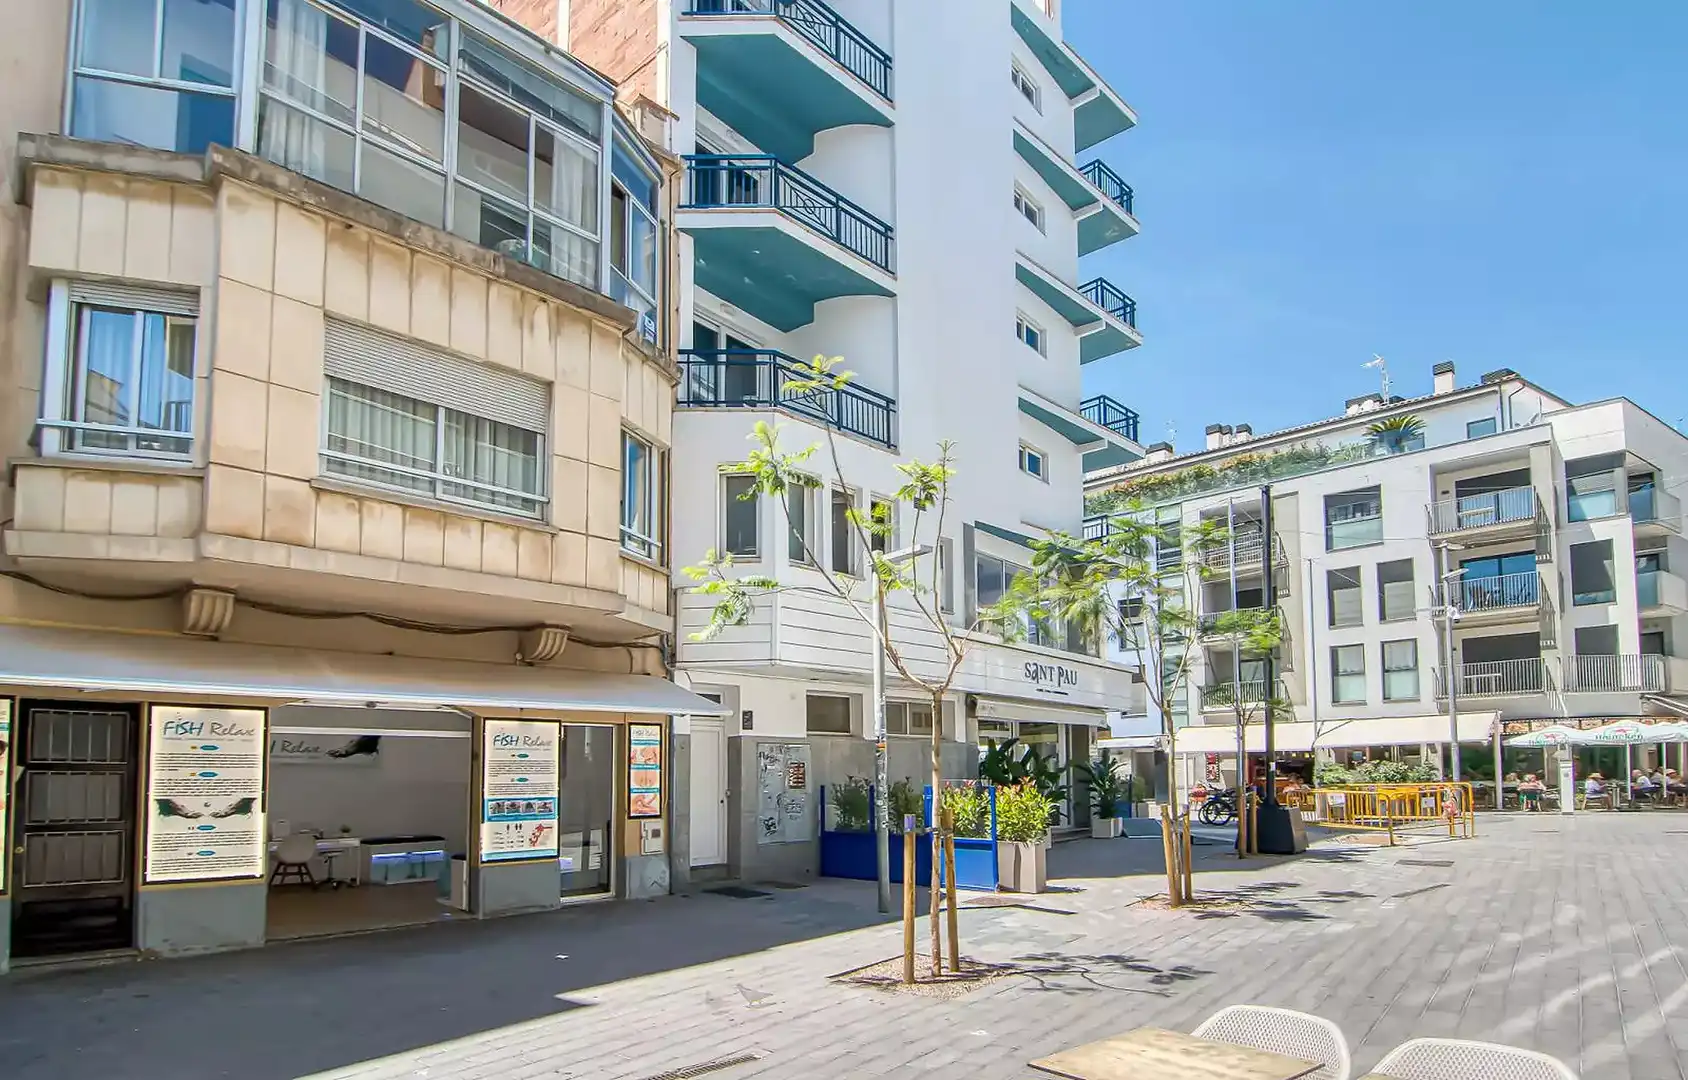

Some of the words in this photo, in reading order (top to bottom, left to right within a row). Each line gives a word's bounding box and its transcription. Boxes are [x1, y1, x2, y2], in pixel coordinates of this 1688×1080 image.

[1057, 666, 1077, 687] PAU
[210, 722, 255, 736] Relax
[281, 740, 321, 754] Relax
[523, 735, 552, 747] Relax
